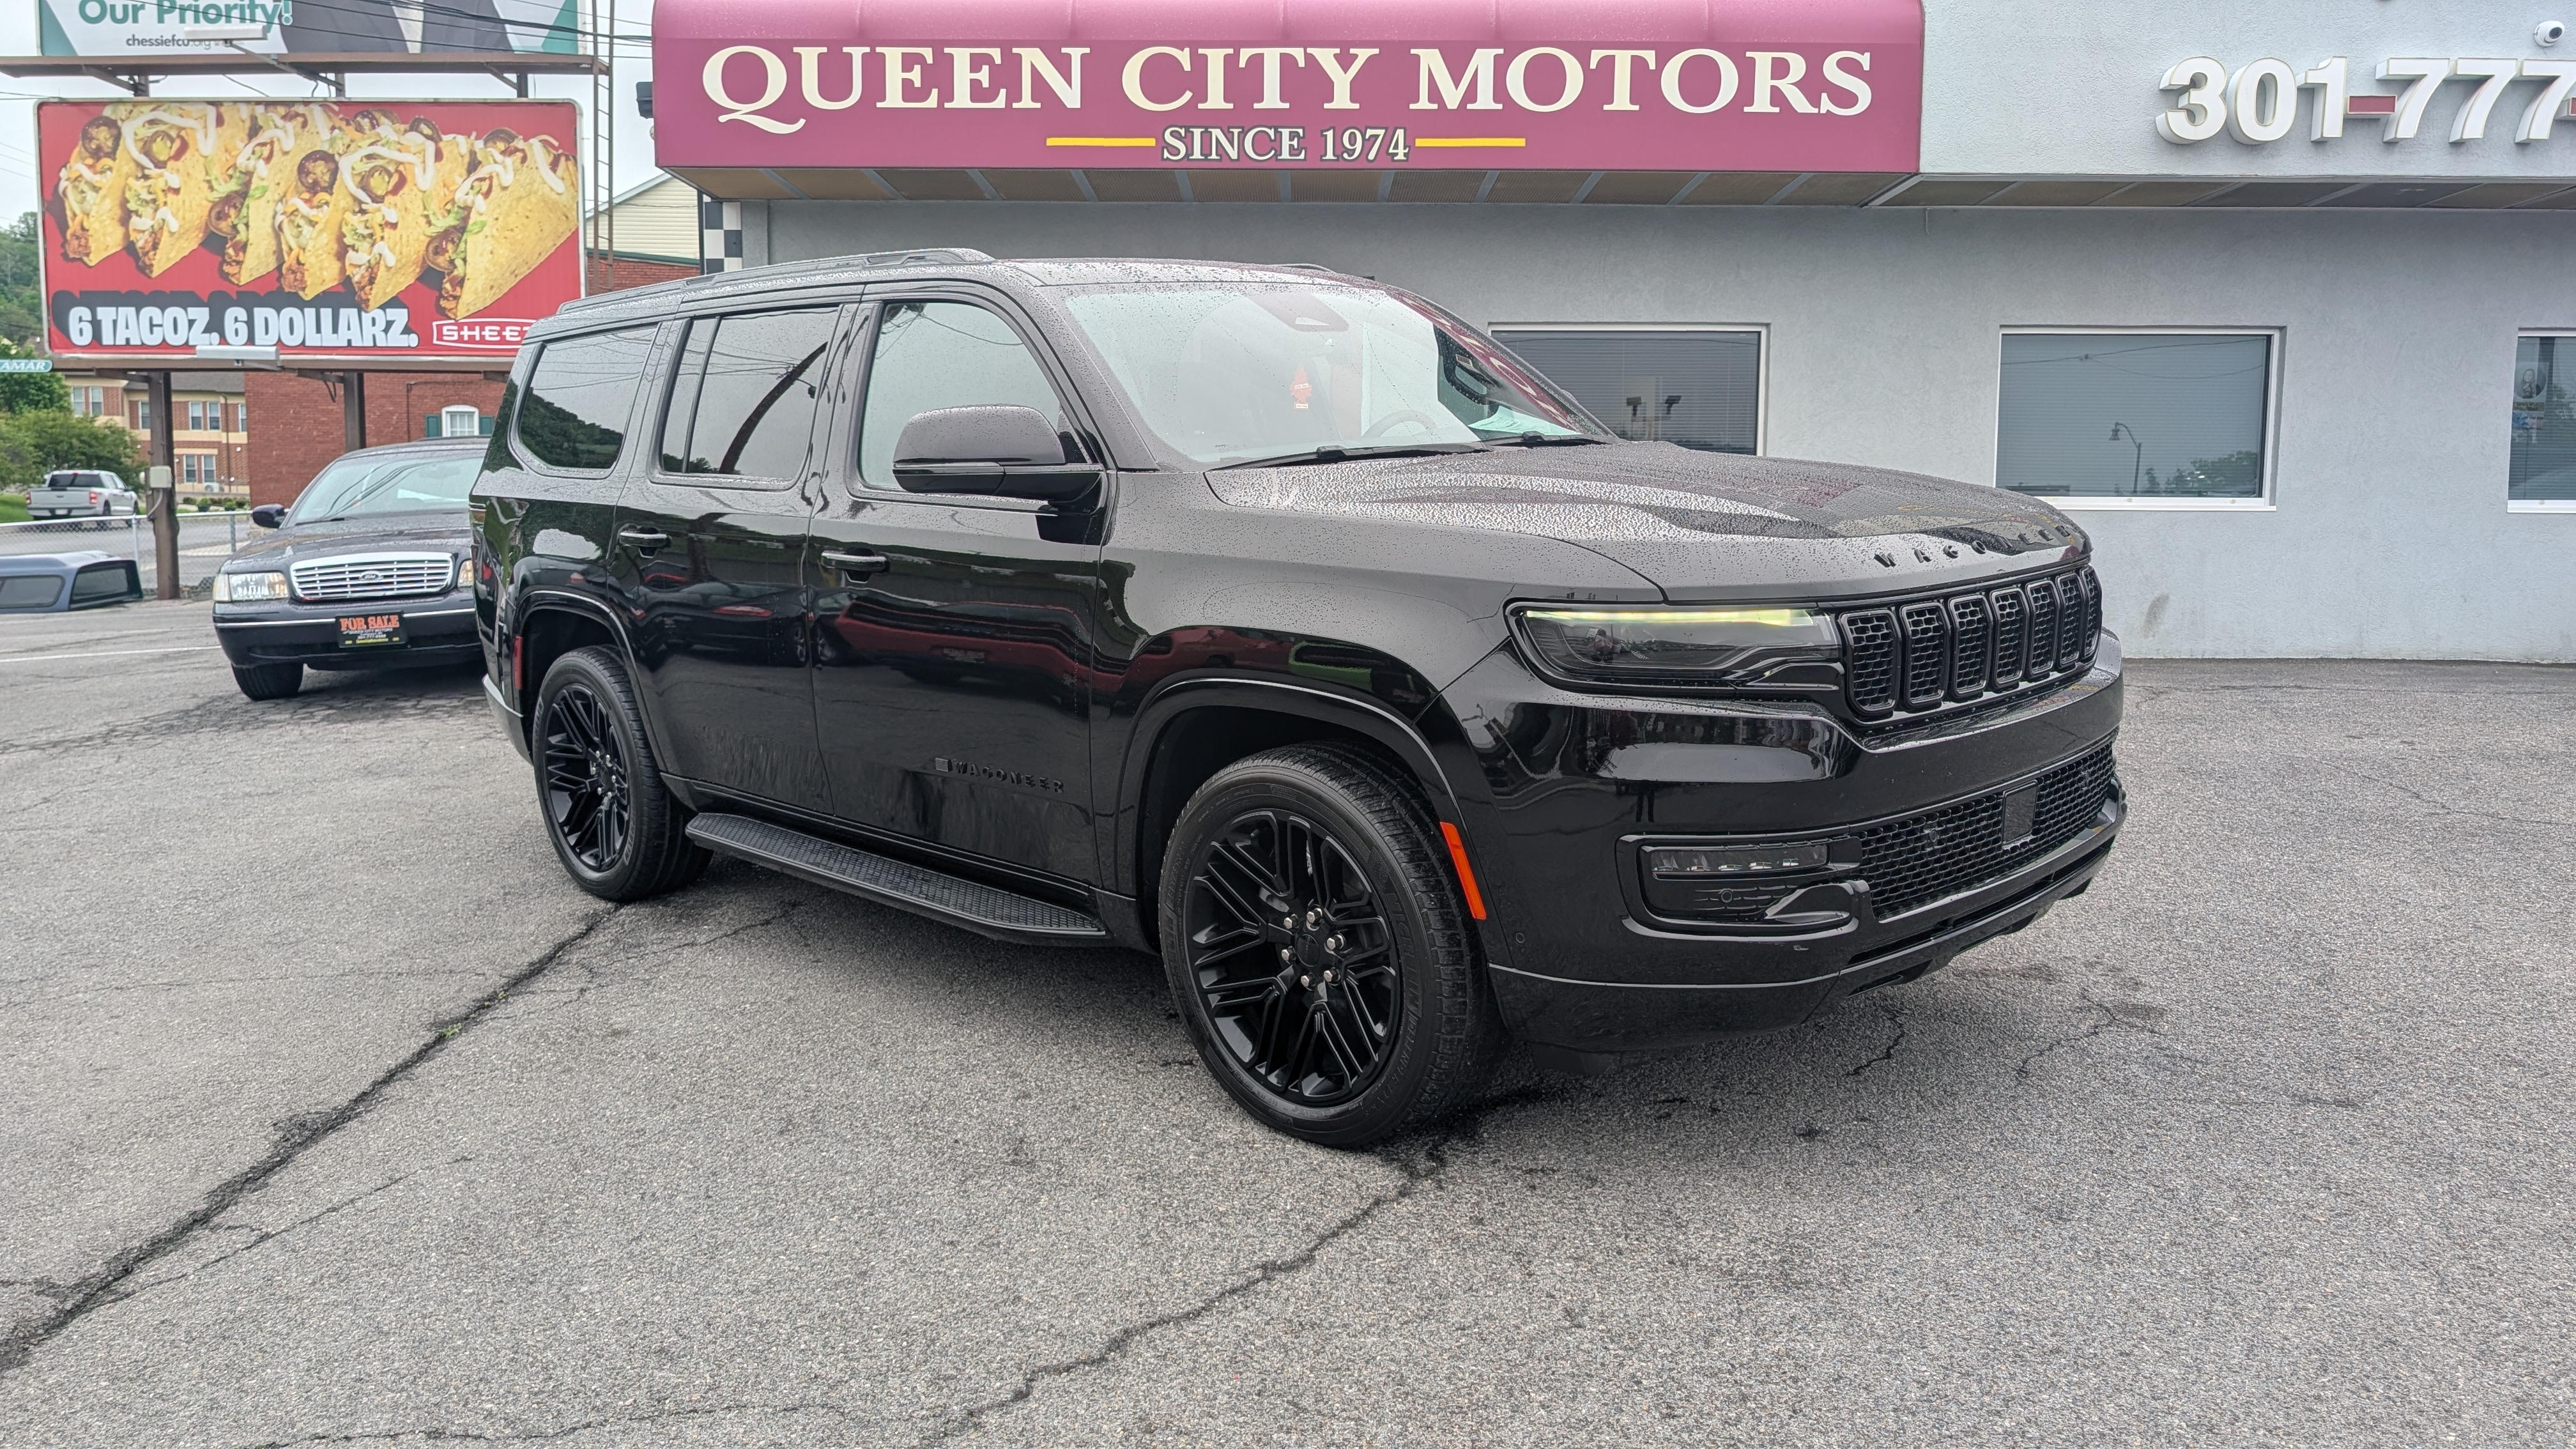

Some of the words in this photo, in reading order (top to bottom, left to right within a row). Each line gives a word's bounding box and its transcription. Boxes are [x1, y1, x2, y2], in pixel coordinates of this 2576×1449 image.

[79, 0, 146, 24] Our
[157, 0, 293, 34] Priority!
[126, 34, 211, 50] chessiefcu.org
[702, 45, 1091, 135] QUEEN
[1121, 46, 1379, 112] CITY
[1408, 47, 1873, 116] MOTORS
[2156, 56, 2576, 144] 301-777
[1162, 126, 1307, 161] SINCE
[1320, 126, 1411, 162] 1974
[68, 306, 93, 346] 6
[96, 306, 220, 346] TACOZ.
[224, 307, 248, 346] 6
[254, 307, 419, 347] DOLLARZ.
[339, 617, 367, 631] FOR
[368, 615, 399, 629] SALE
[951, 758, 1064, 793] WAGONEER
